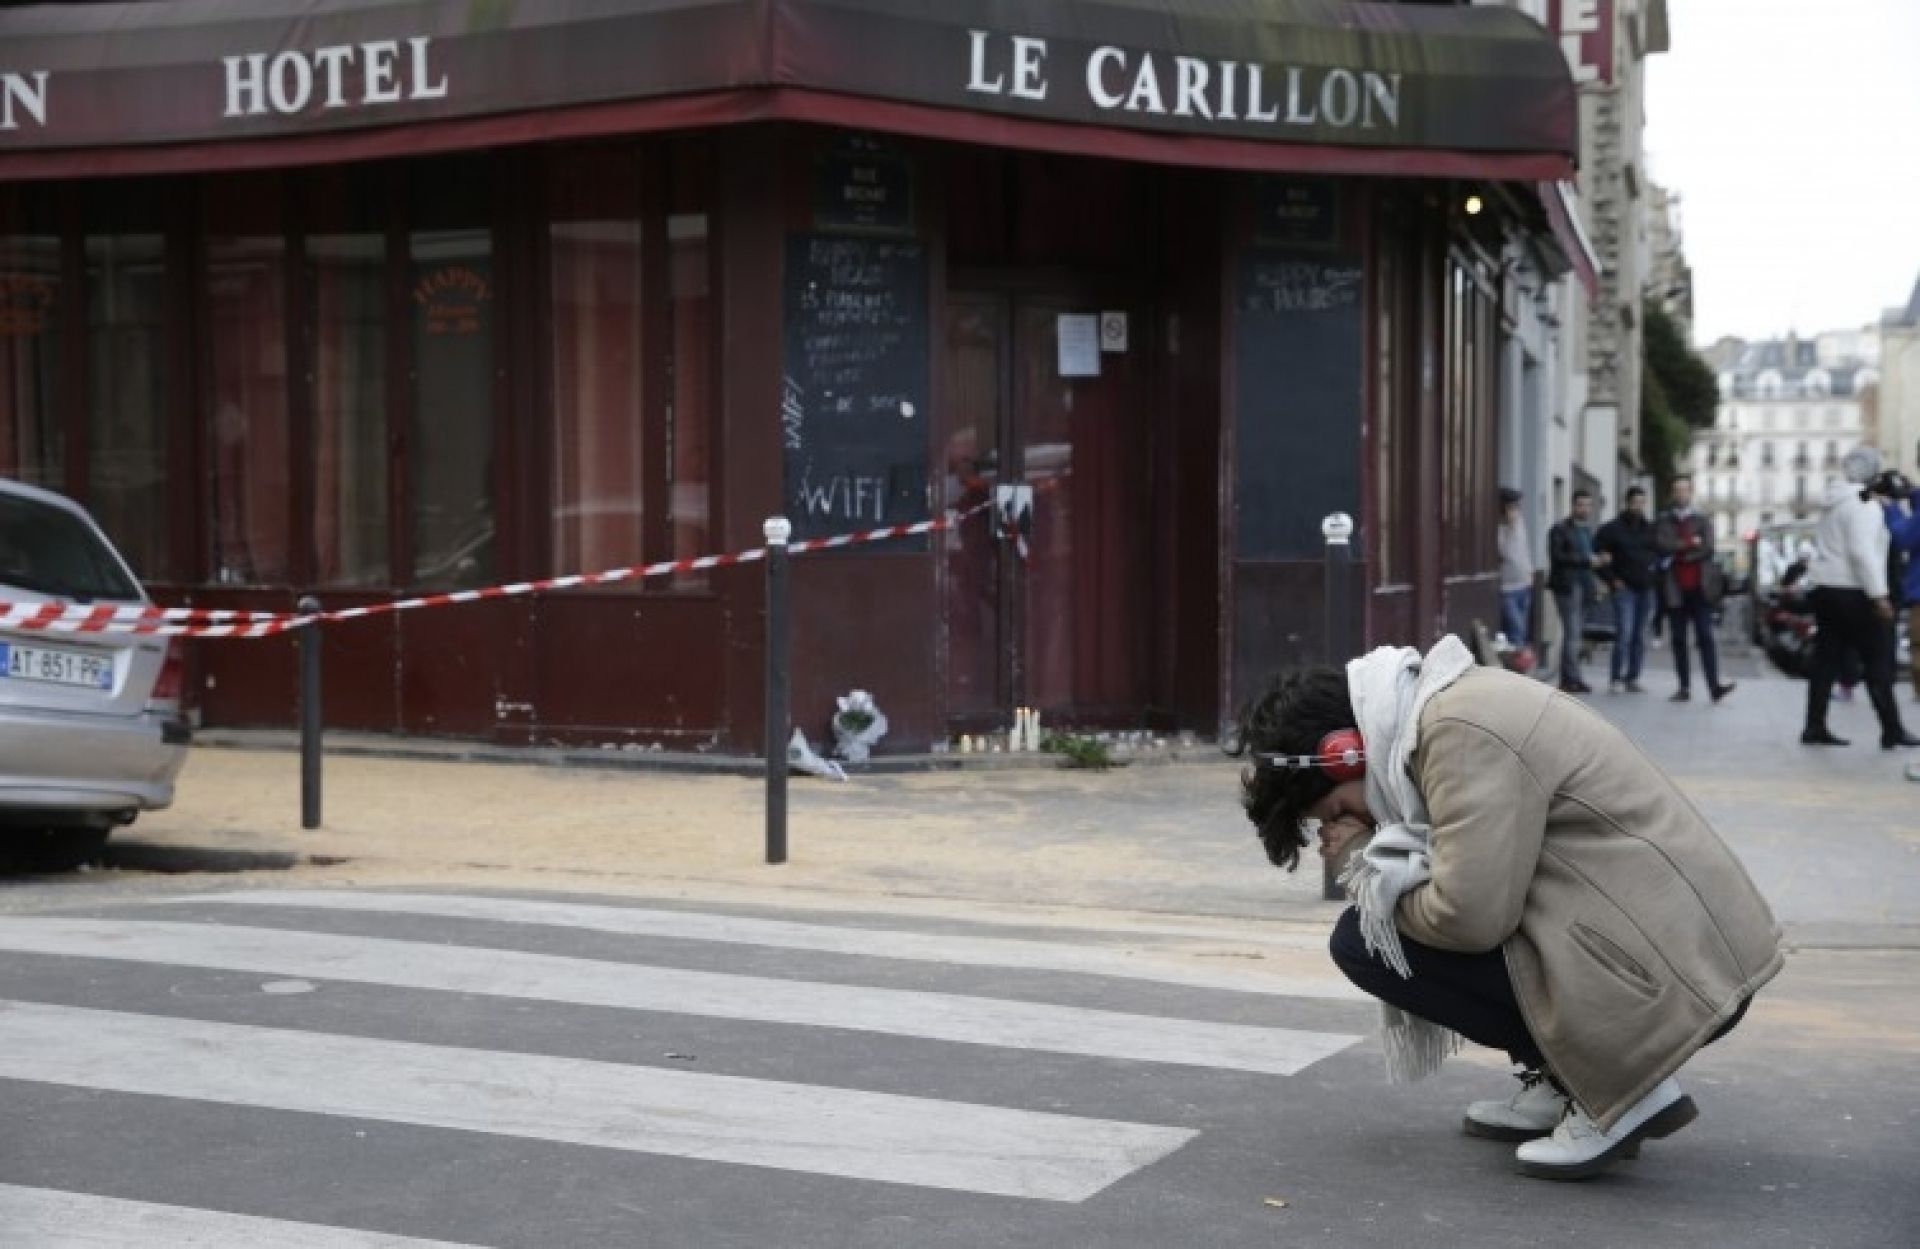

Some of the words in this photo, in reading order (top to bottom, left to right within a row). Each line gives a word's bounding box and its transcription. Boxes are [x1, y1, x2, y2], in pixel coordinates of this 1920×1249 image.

[223, 35, 449, 117] HOTEL
[966, 30, 1049, 99] LE
[1086, 46, 1400, 128] CARILLON
[11, 649, 34, 675] AT
